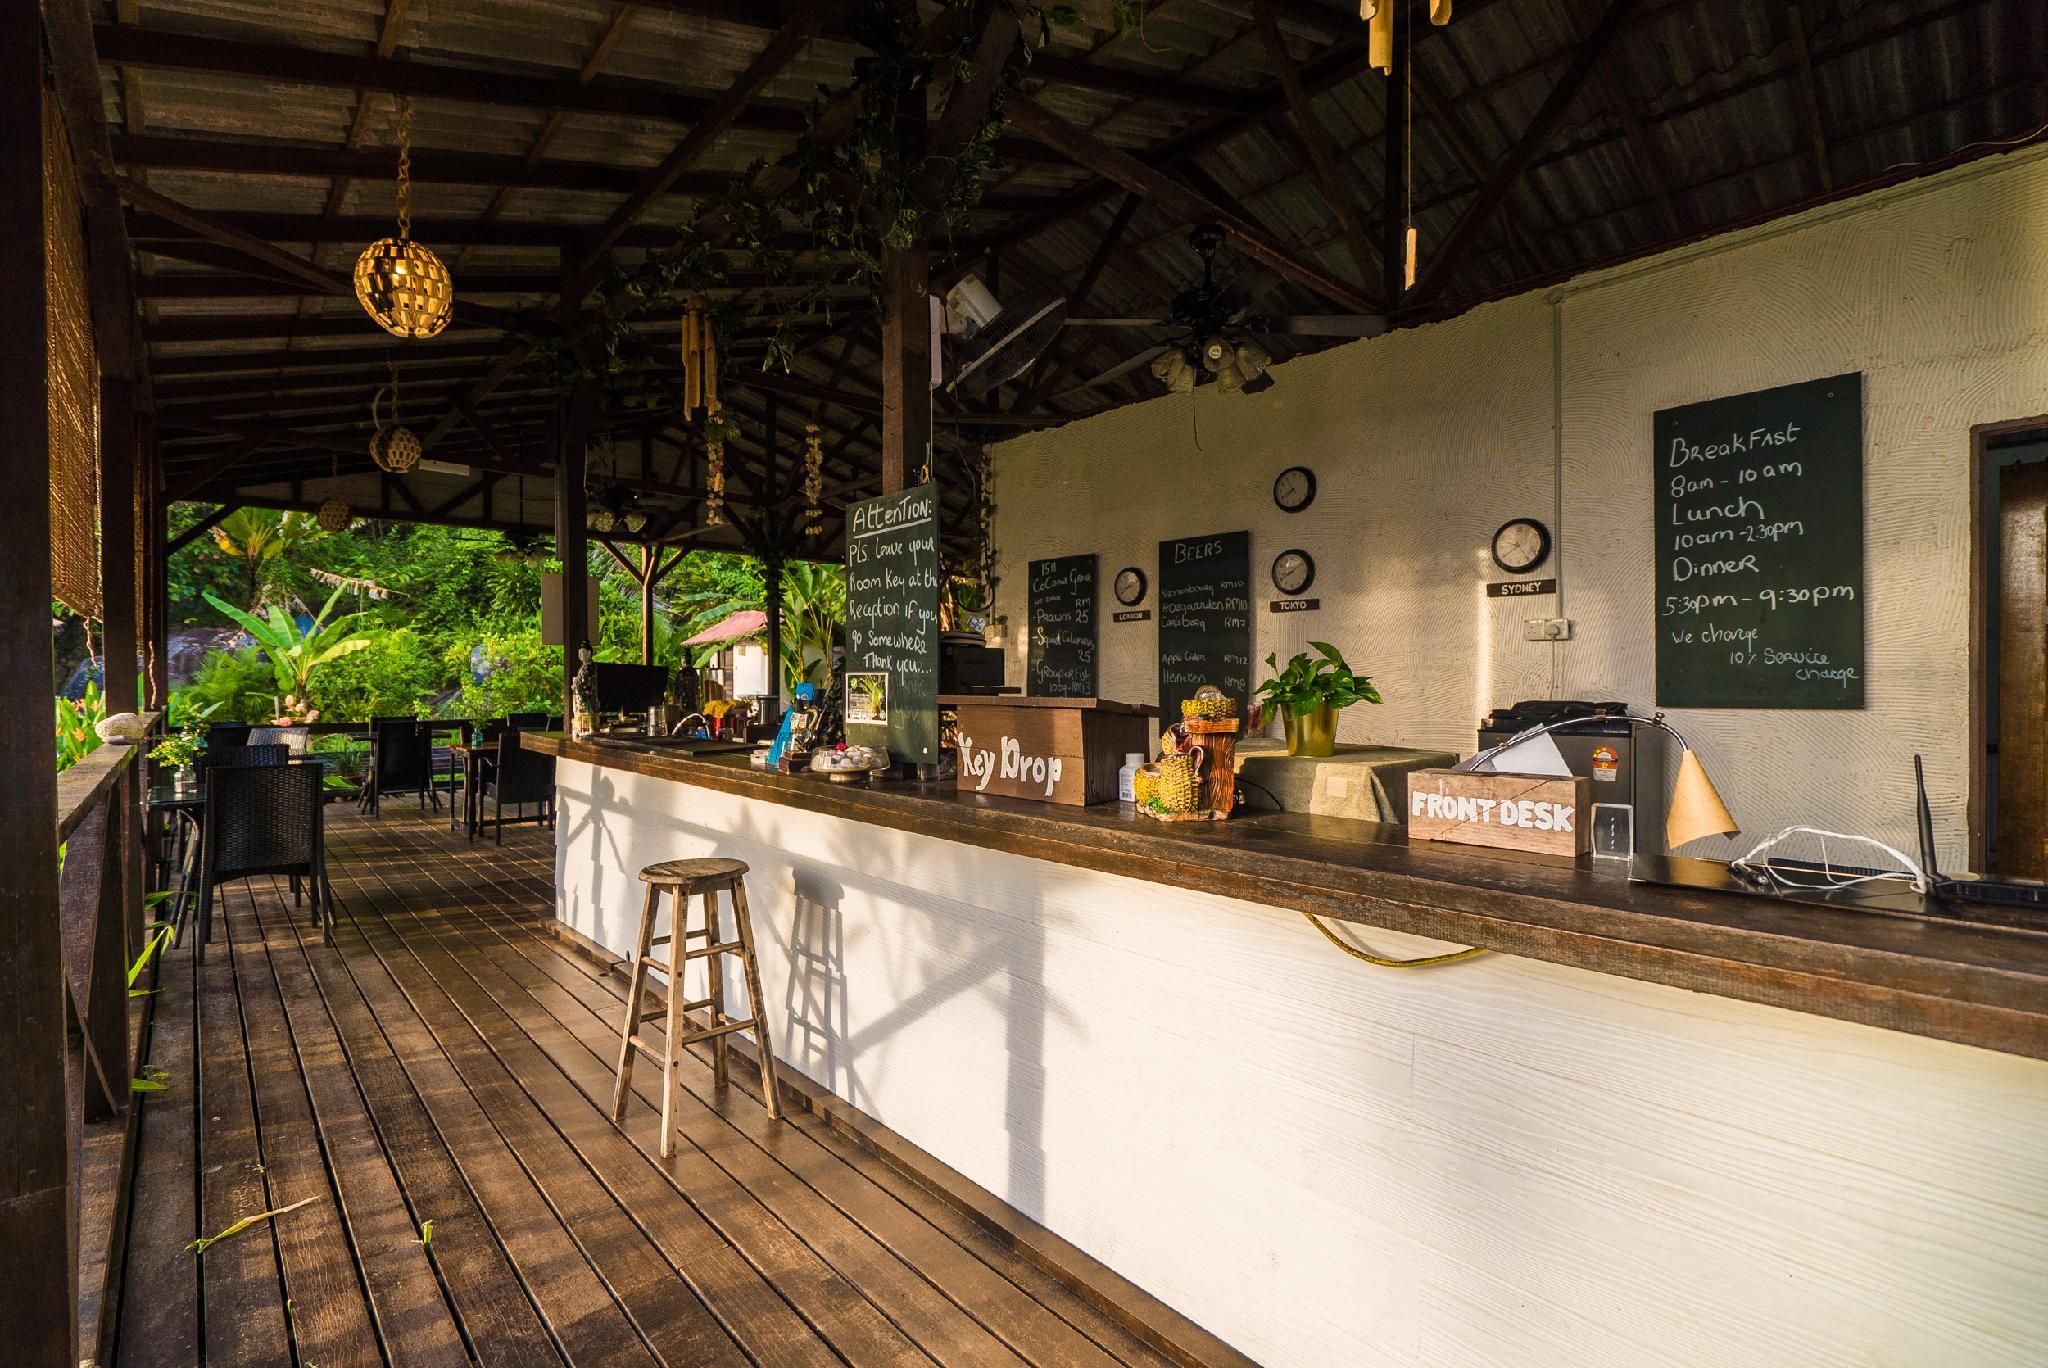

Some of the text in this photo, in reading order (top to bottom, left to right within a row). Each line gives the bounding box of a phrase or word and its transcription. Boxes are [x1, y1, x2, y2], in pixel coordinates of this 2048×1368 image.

[1672, 496, 1765, 526] Lunch
[1174, 540, 1223, 565] BEERS
[1501, 582, 1542, 595] SYDNEY
[1759, 585, 1855, 611] 9:30pm
[1075, 609, 1090, 624] 25
[1278, 601, 1307, 610] TOKYO
[957, 731, 996, 792] Key
[1000, 735, 1063, 797] Drop
[1411, 790, 1577, 833] FRONT DESK
